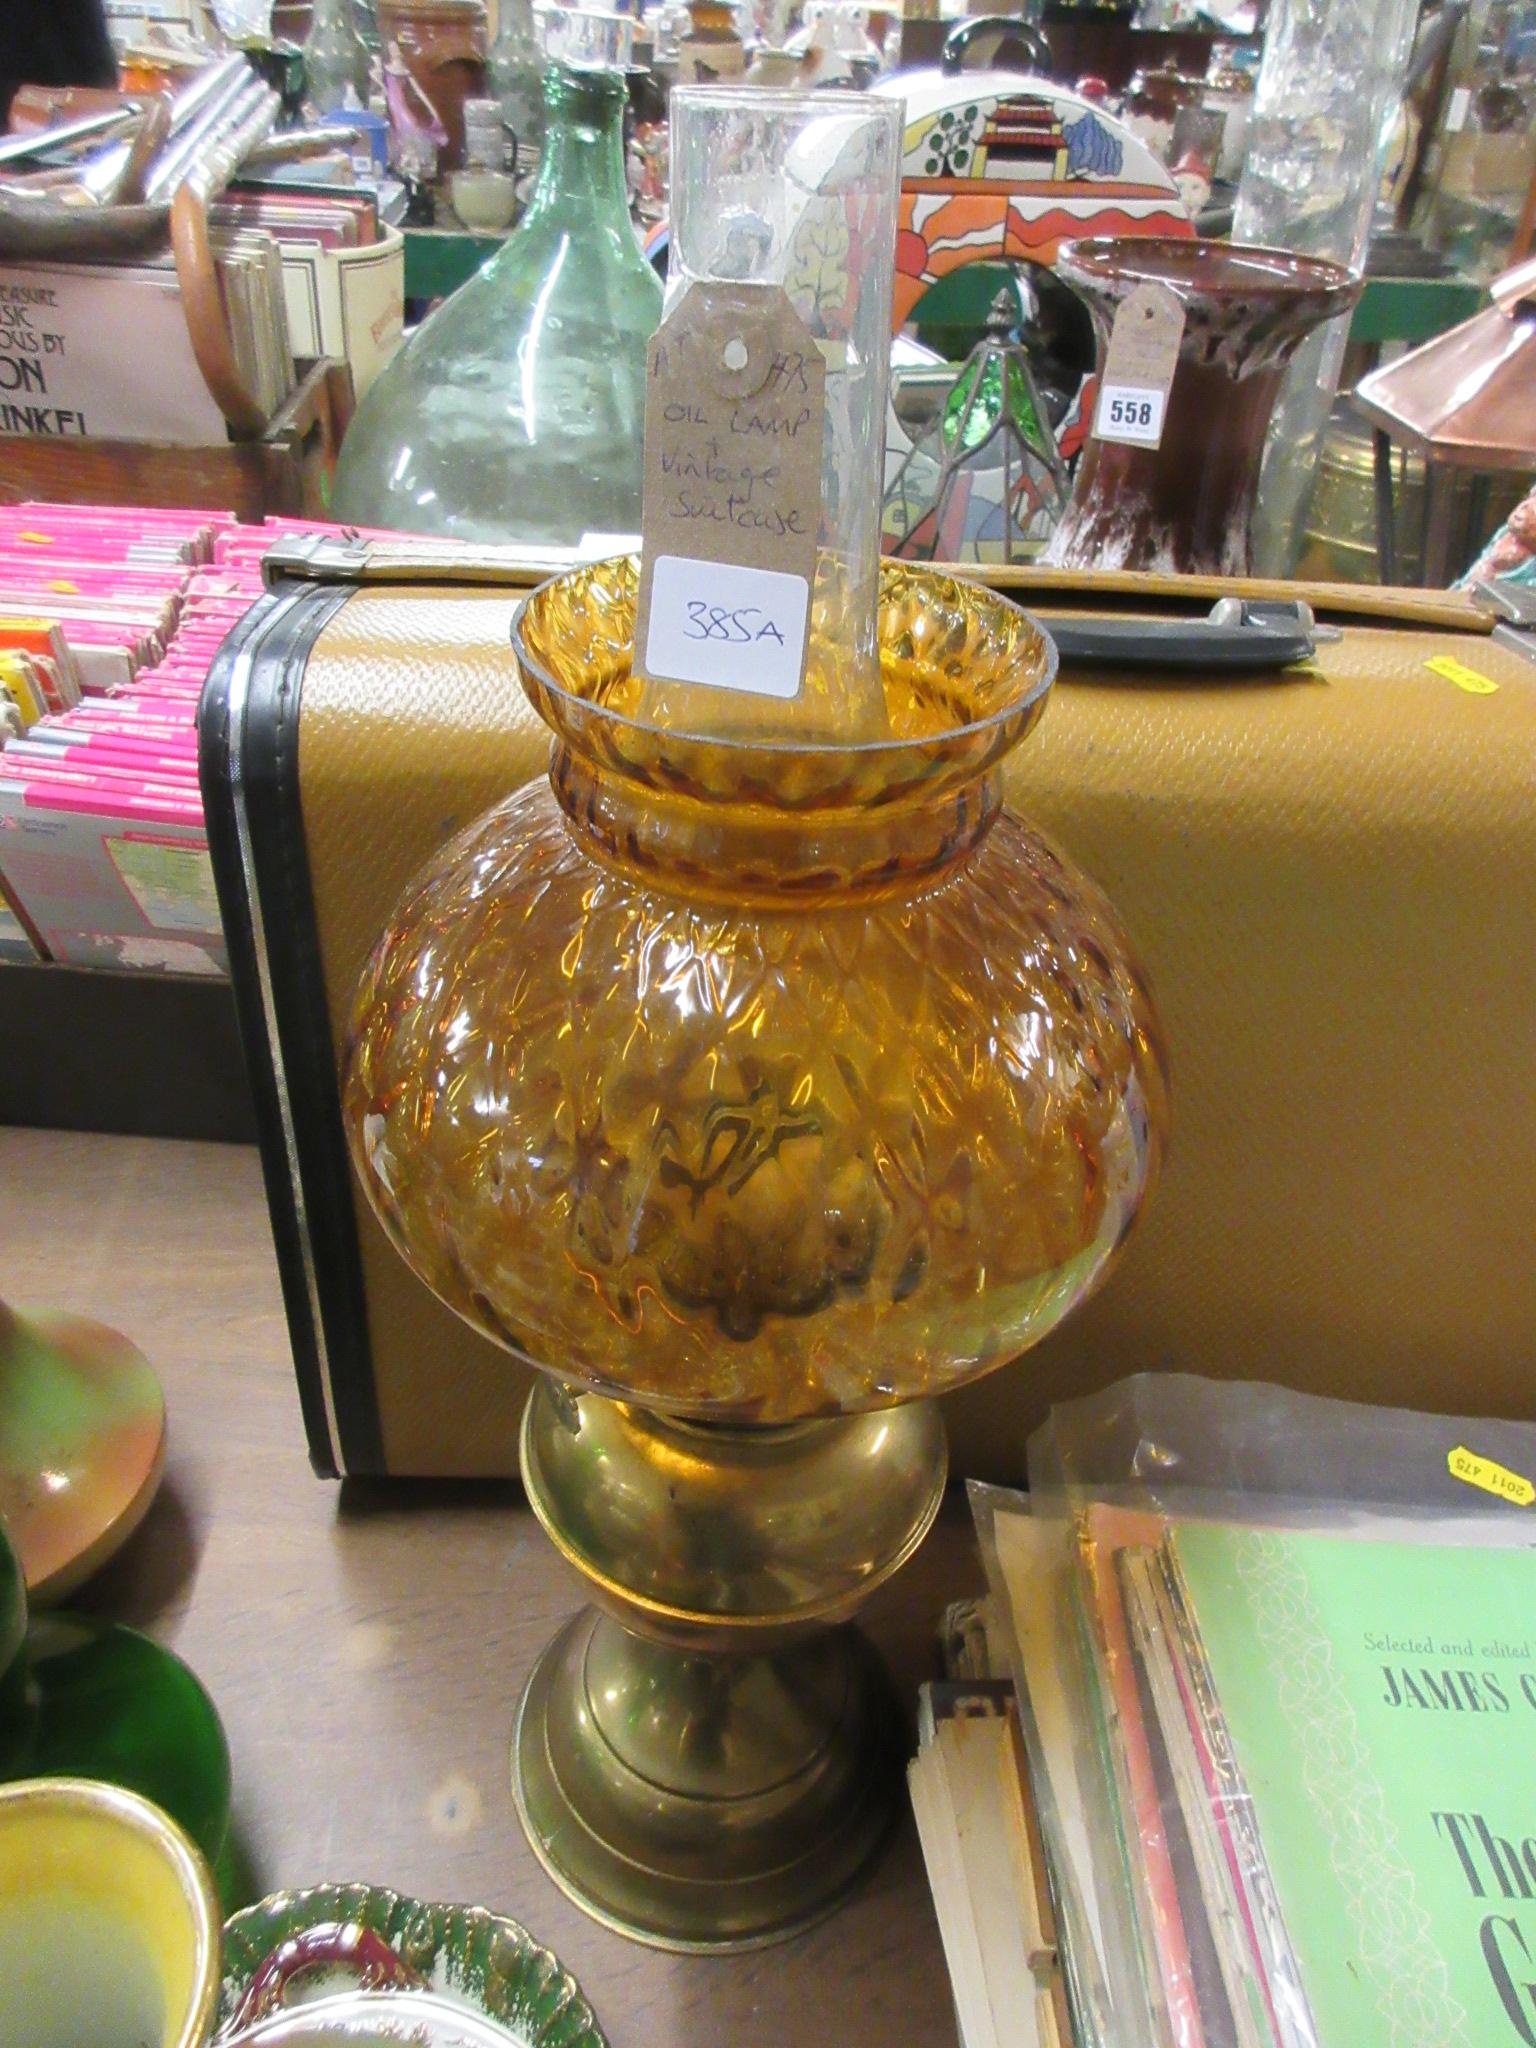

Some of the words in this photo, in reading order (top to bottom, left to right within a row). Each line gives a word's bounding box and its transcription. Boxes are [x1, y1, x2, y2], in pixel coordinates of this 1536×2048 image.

[42, 333, 66, 355] BY
[0, 355, 47, 393] ON
[663, 403, 708, 424] OIL
[730, 408, 810, 437] LAMP
[1111, 400, 1152, 425] 558
[683, 601, 785, 646] 385A
[1492, 1473, 1525, 1497] 2011
[1364, 1632, 1434, 1654] Selected
[1441, 1640, 1473, 1656] and
[1481, 1641, 1531, 1658] edited
[1381, 1666, 1510, 1713] JAMES
